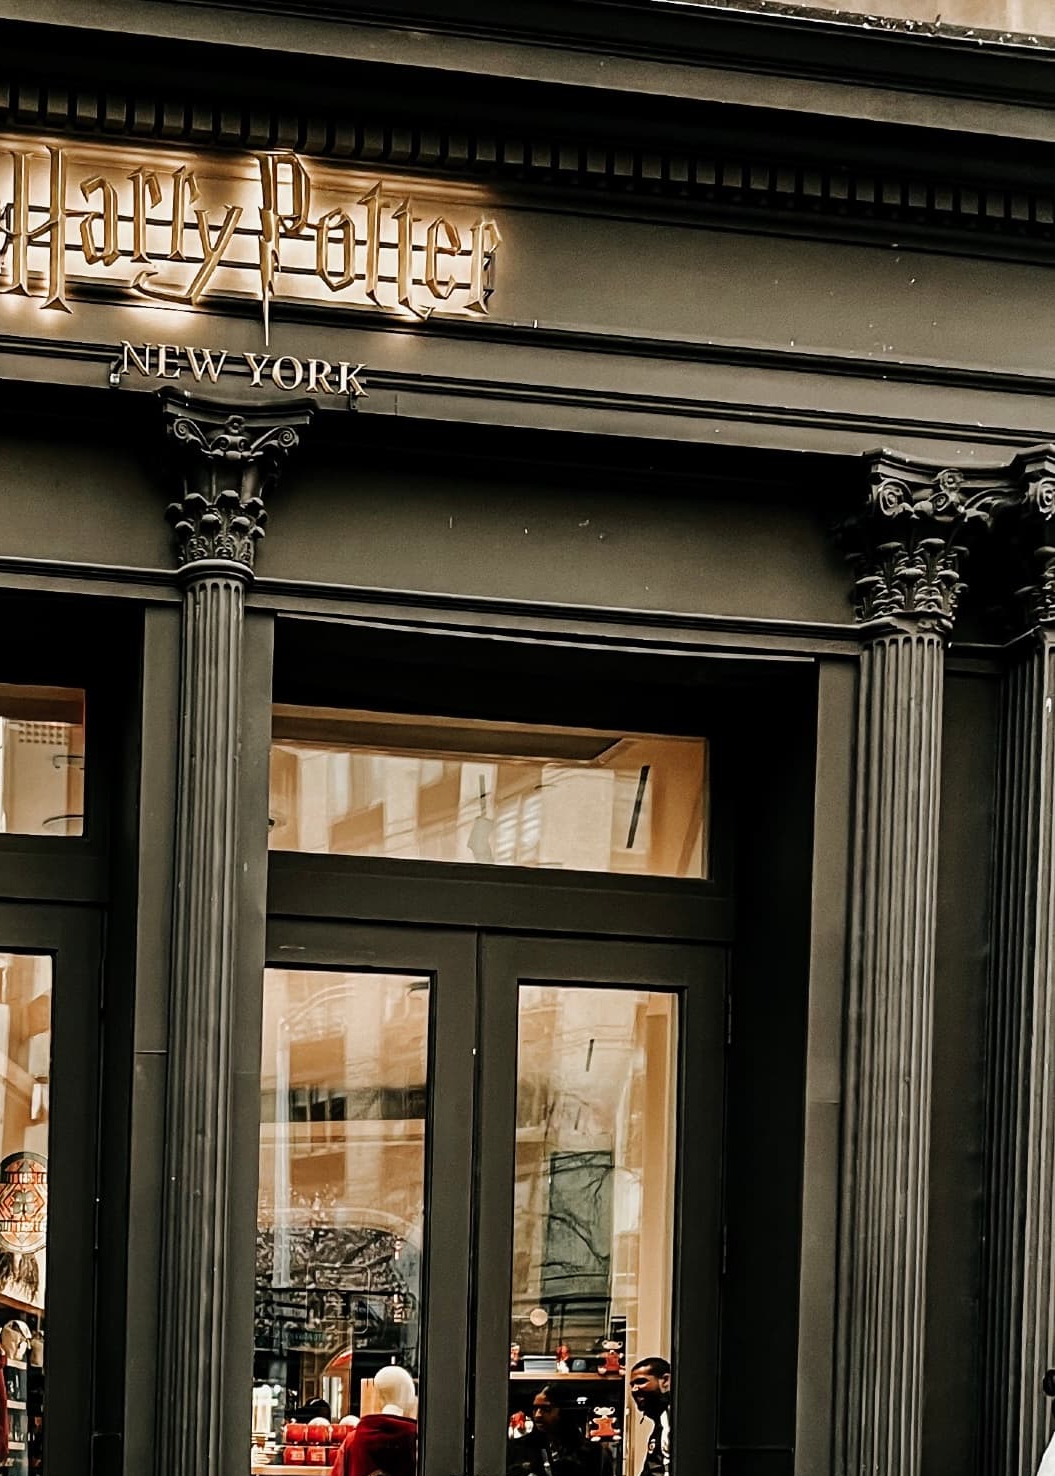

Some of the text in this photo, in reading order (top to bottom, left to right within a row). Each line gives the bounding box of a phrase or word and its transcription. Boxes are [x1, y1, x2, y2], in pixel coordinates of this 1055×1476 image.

[255, 150, 503, 346] Potter
[120, 340, 370, 397] NEW YORK
